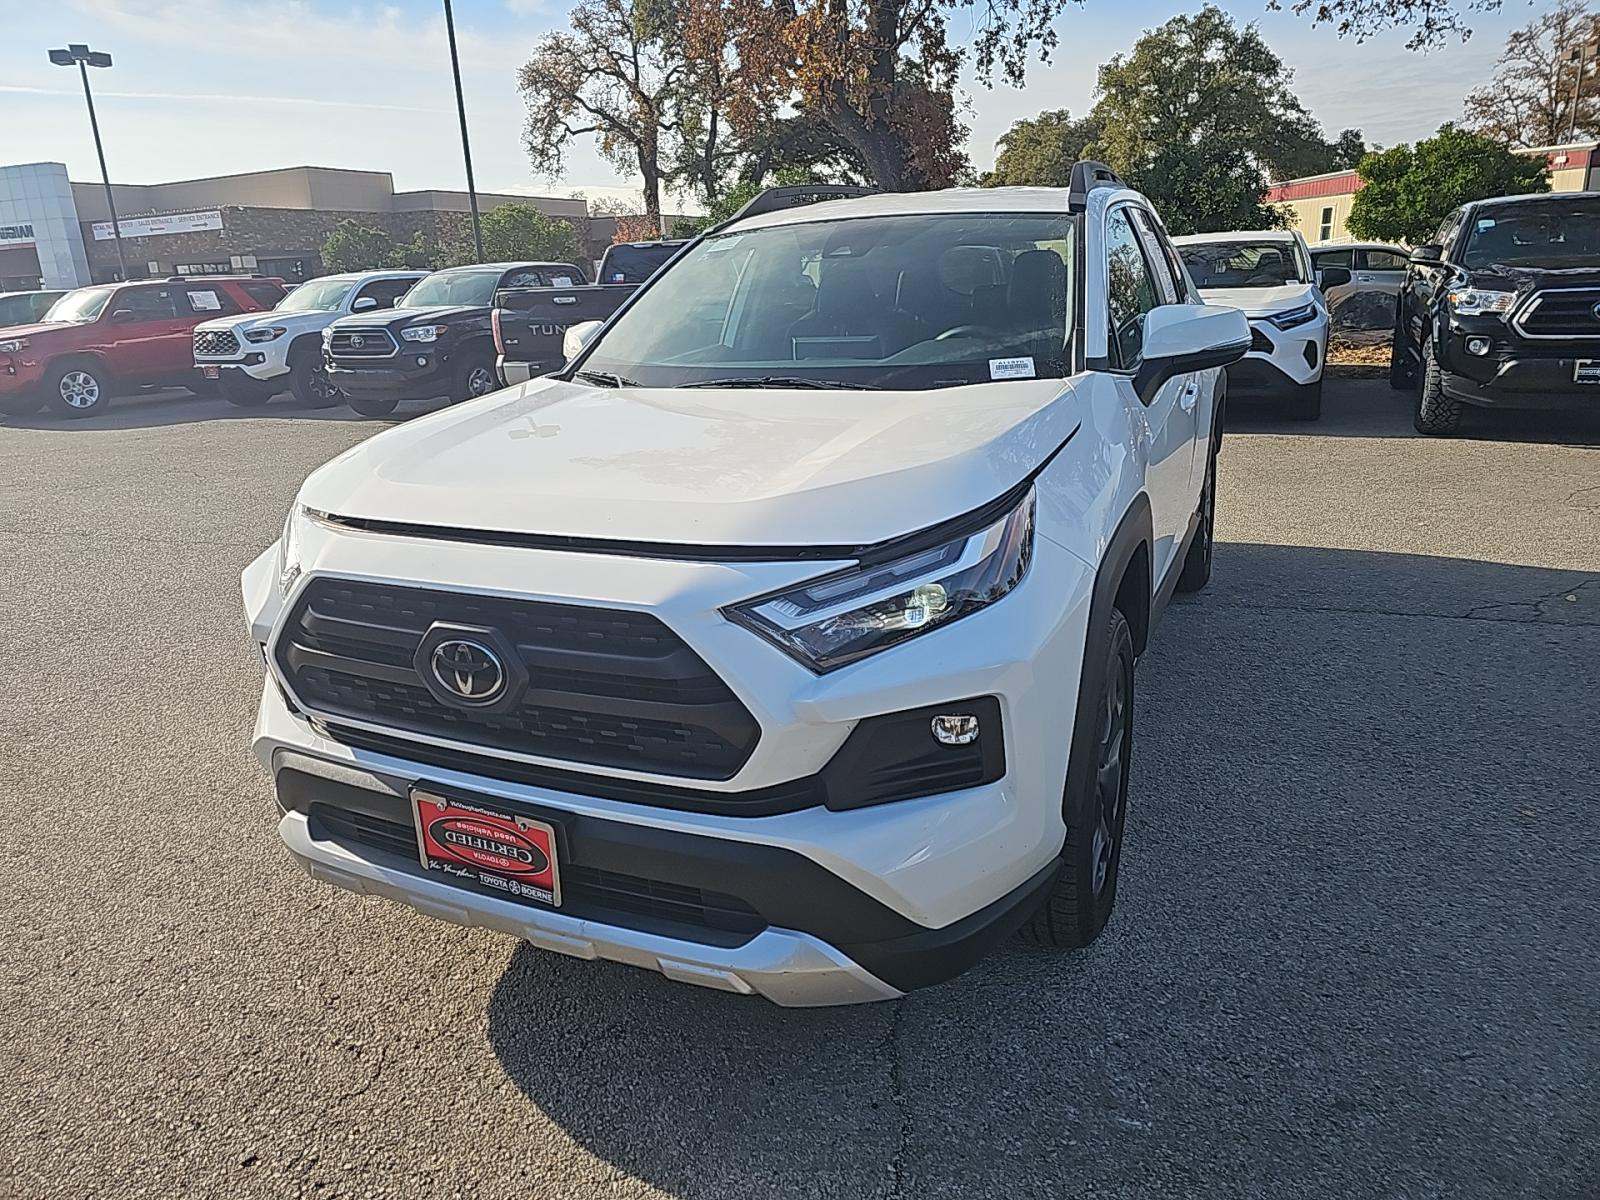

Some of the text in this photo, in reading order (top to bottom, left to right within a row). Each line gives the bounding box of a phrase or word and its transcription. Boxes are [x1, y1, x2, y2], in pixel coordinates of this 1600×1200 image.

[178, 213, 220, 225] SERVICE ENTRANCE
[528, 324, 573, 336] TUN
[456, 822, 517, 843] Used Vehicles
[445, 831, 533, 863] CERTIFIED
[473, 852, 501, 865] TOYOTA
[479, 875, 553, 902] TOYOTA BOERNE
